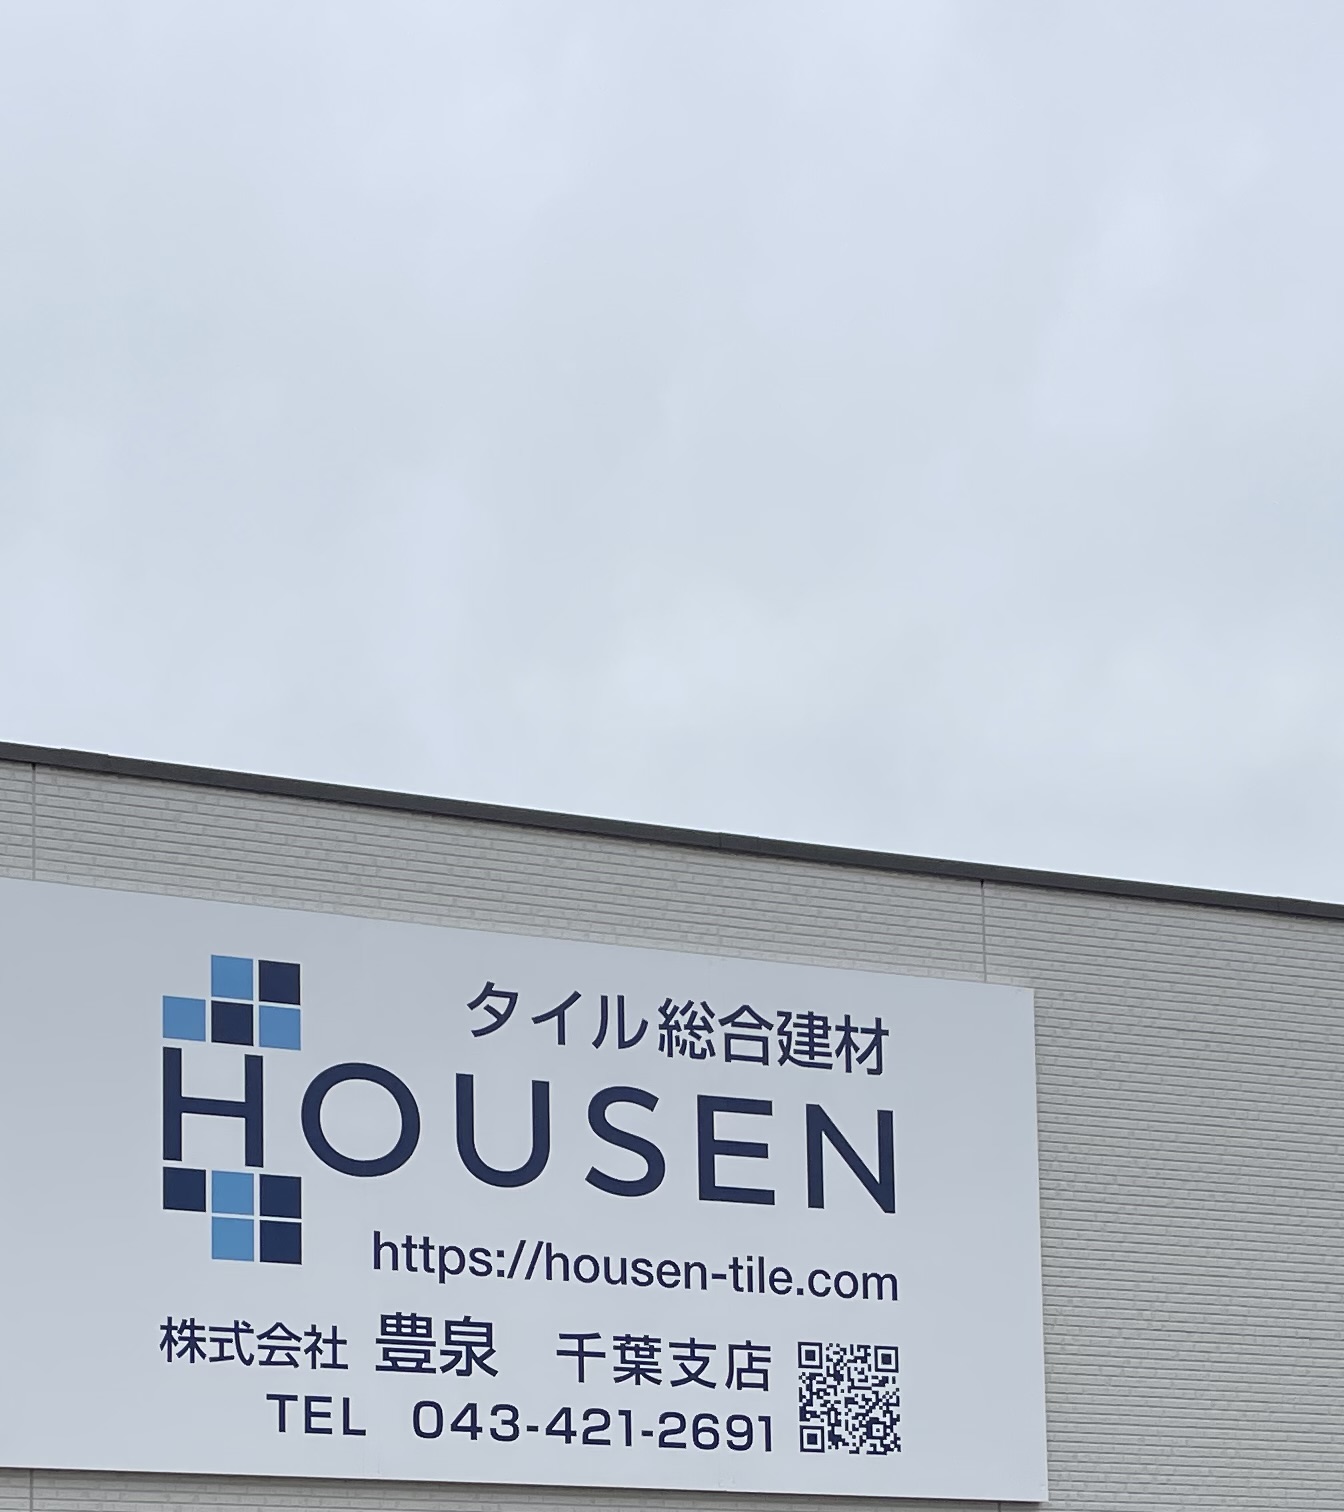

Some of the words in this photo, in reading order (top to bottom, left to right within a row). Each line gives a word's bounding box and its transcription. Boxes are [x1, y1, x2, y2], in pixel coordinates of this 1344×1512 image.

[466, 981, 890, 1076] タイル総合建材
[162, 1046, 896, 1214] HOUSEN
[373, 1230, 898, 1302] https://housen-tile.com
[159, 1316, 349, 1370] 株式会社
[375, 1311, 499, 1378] 豊泉
[556, 1332, 772, 1392] 千葉支店
[265, 1393, 367, 1437] TEL
[412, 1400, 772, 1453] 043-421-2691
